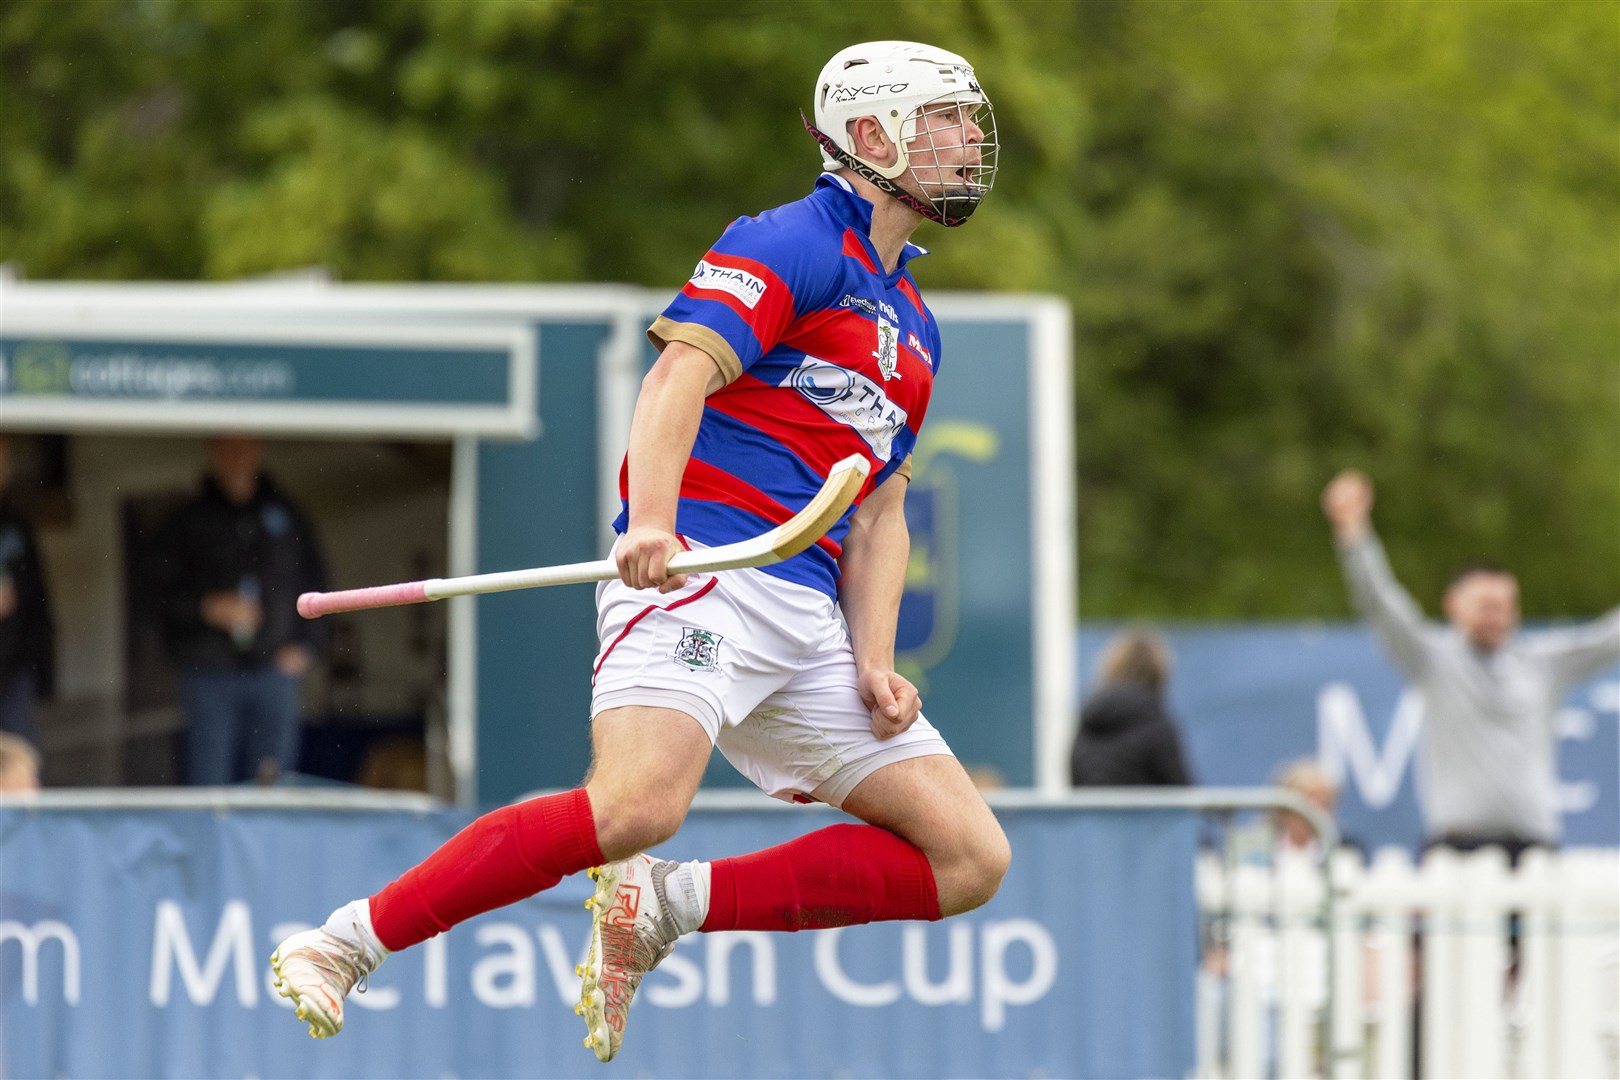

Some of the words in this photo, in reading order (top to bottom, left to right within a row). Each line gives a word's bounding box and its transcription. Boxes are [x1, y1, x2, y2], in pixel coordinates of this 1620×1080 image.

[710, 268, 764, 294] THAIN
[149, 899, 775, 1008] Mavsh
[813, 917, 1059, 1033] Cup
